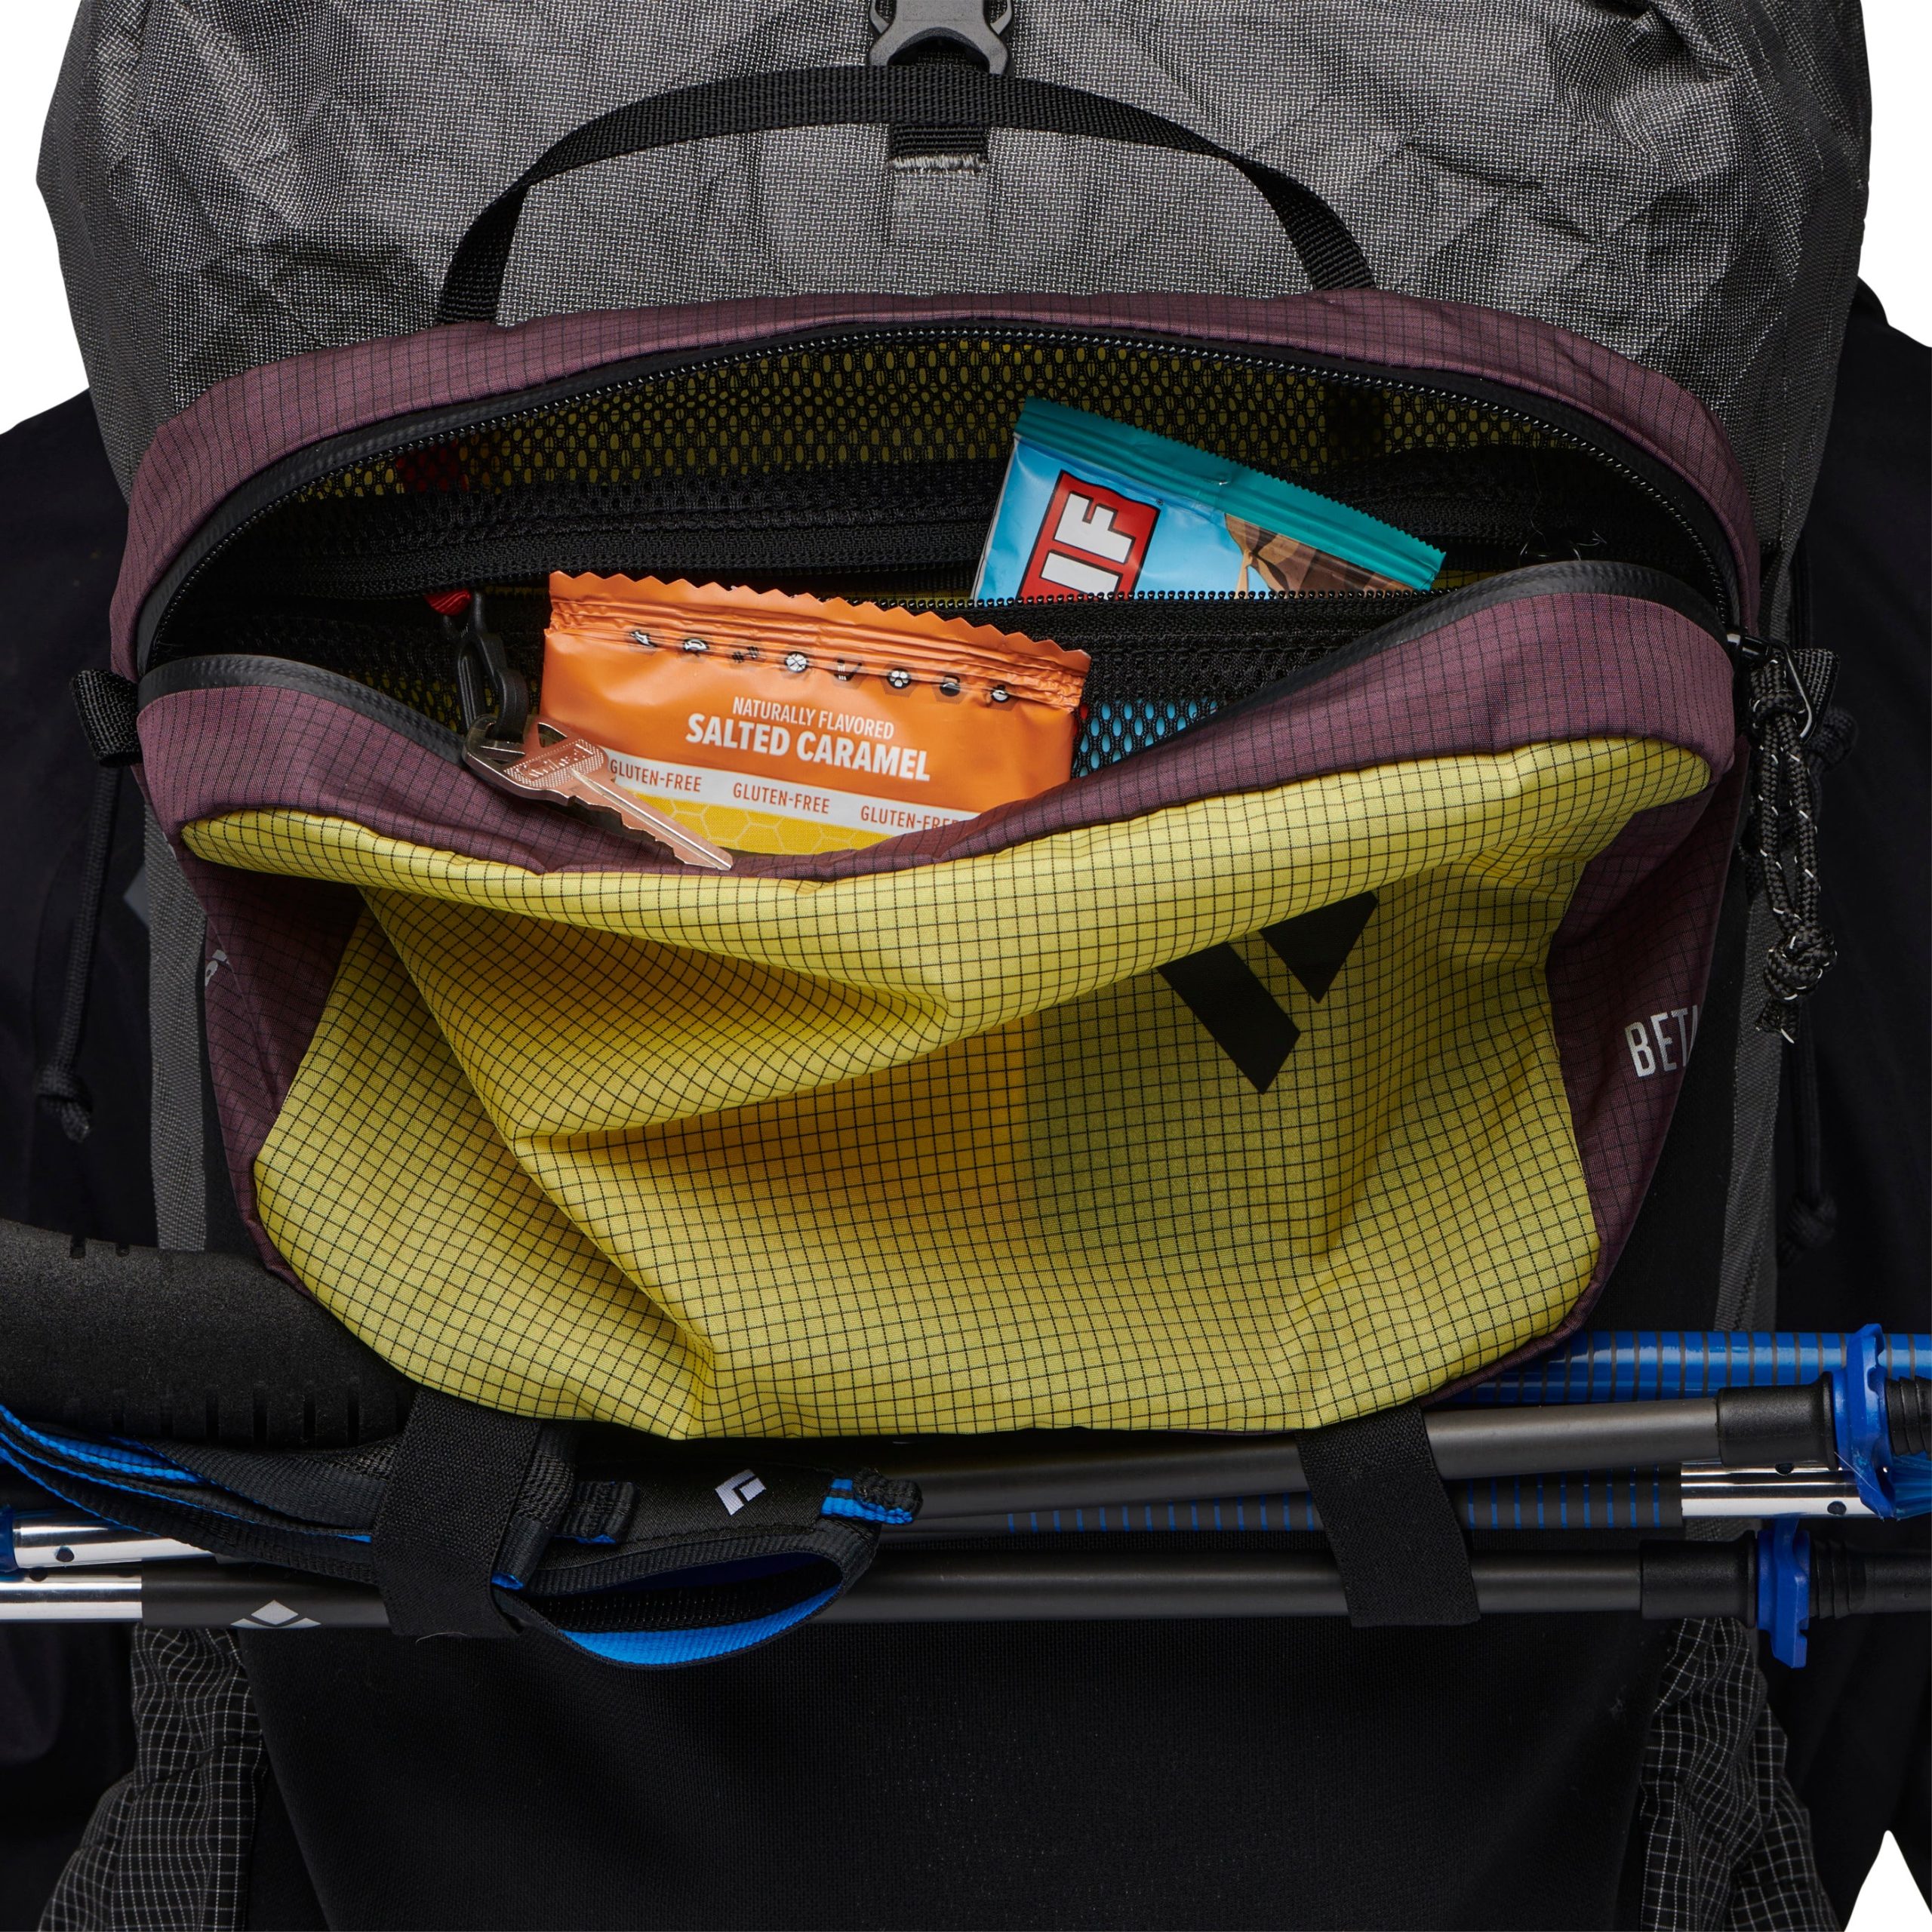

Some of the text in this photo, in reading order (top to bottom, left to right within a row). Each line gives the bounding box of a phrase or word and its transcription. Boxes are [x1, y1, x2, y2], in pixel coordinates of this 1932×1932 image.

[685, 712, 931, 782] SALTED CARAMEL
[732, 696, 894, 740] NATURALLY FLAVORED
[610, 759, 702, 792] GLUTEN-FREE
[733, 782, 830, 814] GLUTEN-FREE
[860, 805, 959, 830] GLUTEN-FR
